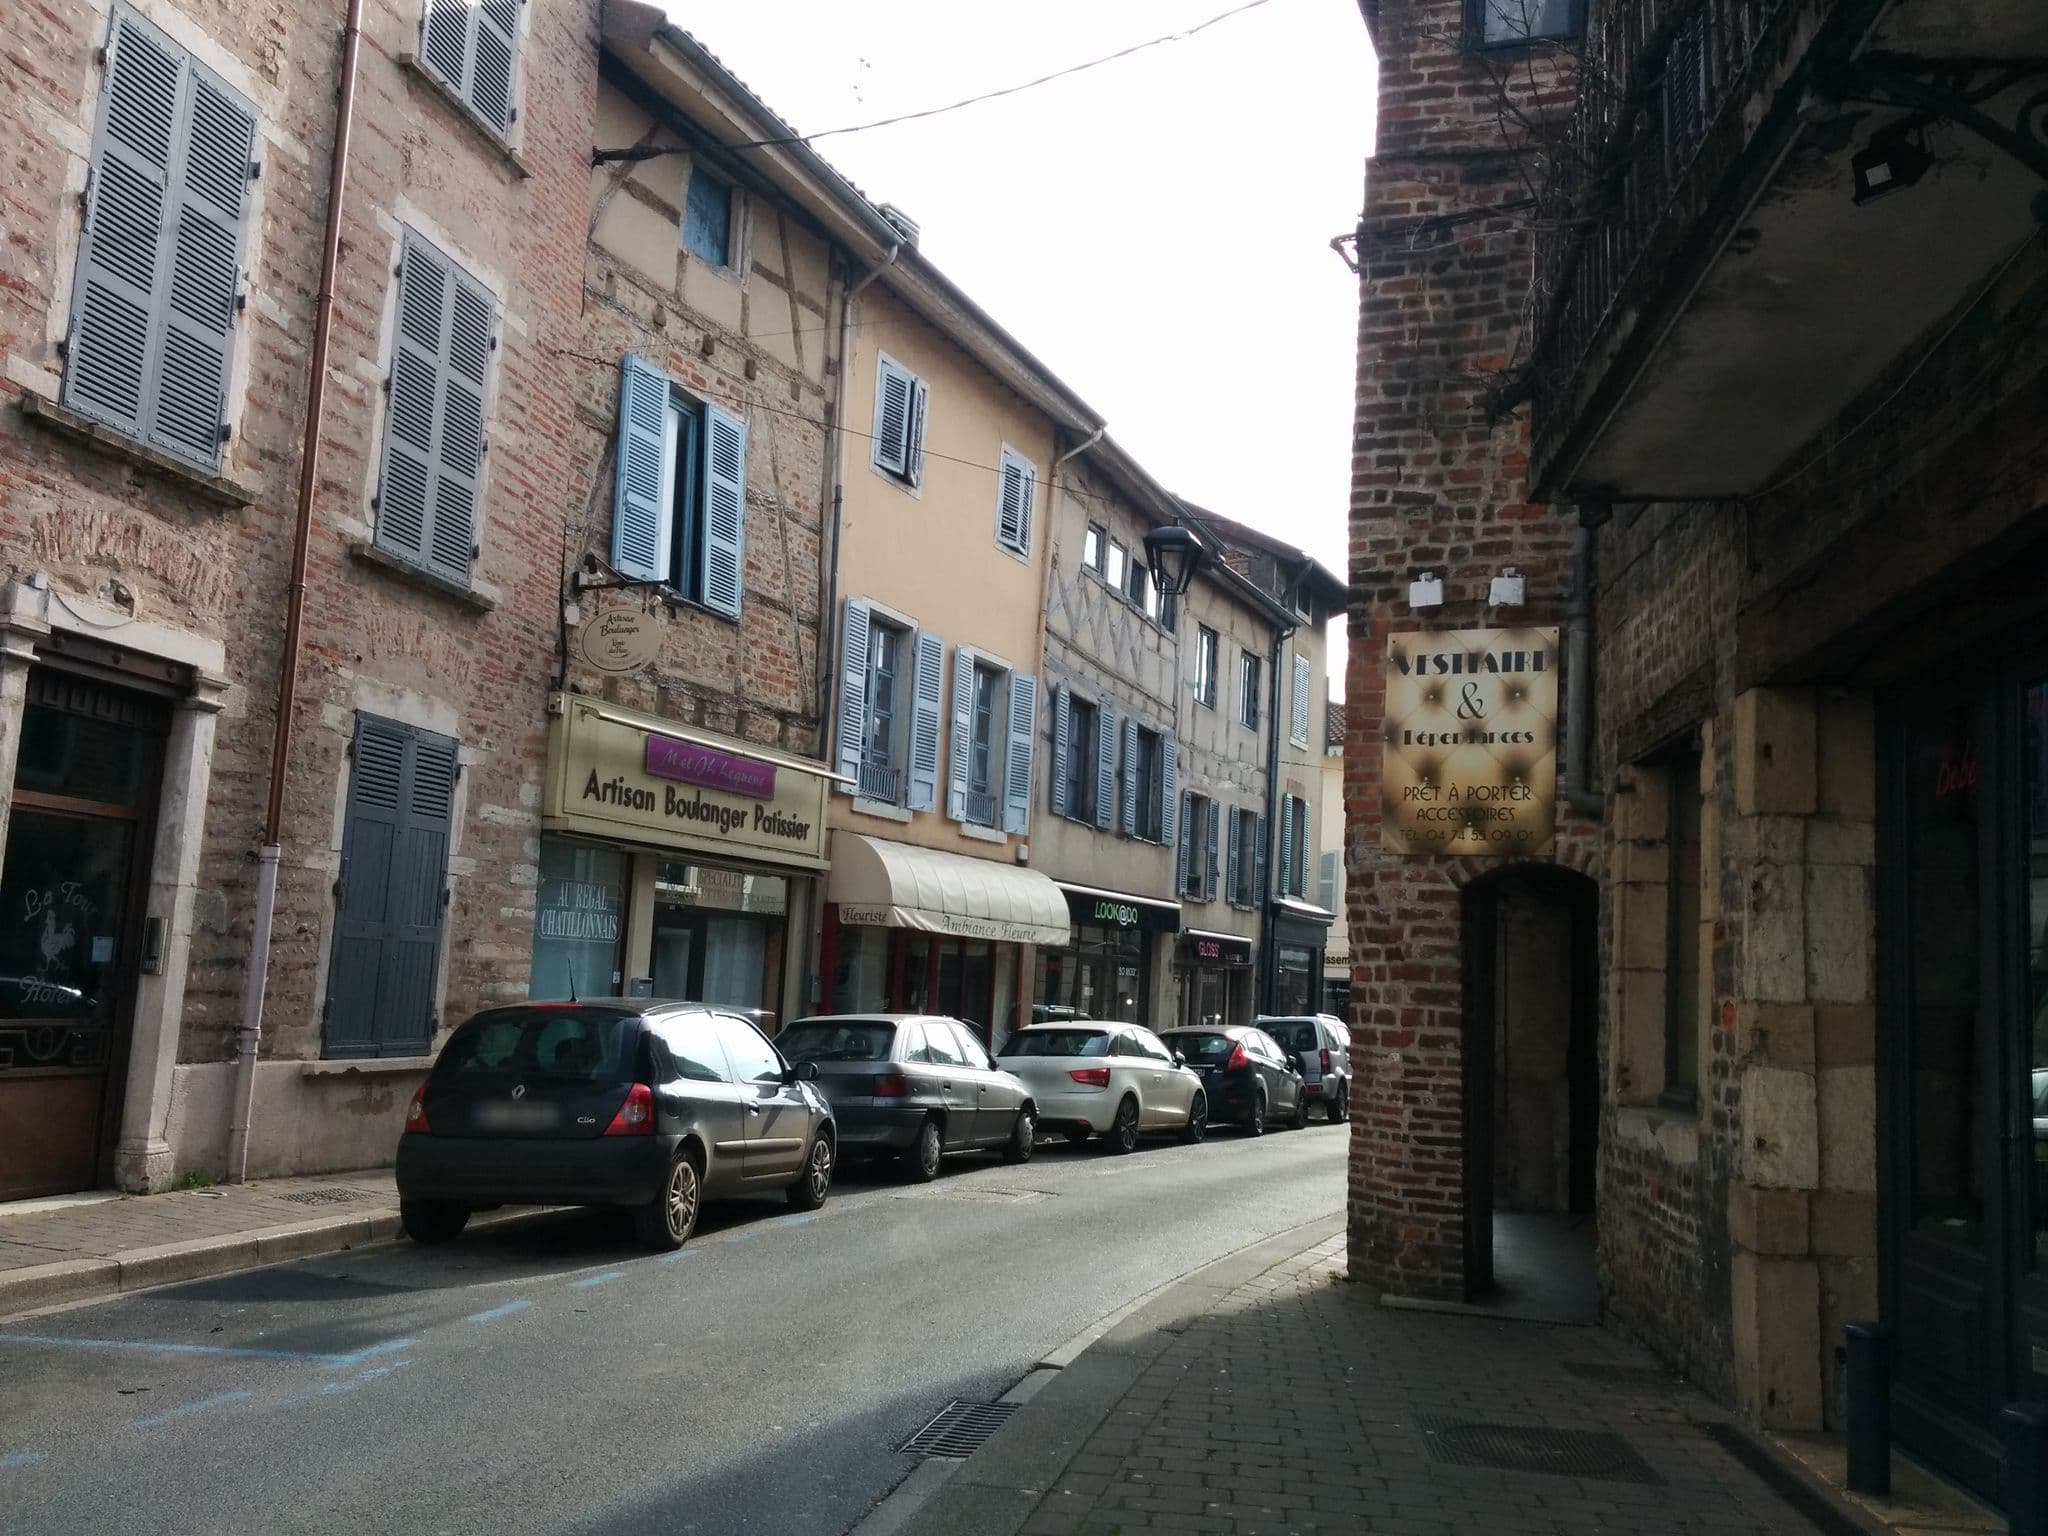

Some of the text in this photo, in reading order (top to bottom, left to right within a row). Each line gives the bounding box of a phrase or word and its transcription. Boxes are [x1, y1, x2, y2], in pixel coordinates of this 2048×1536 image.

[1392, 650, 1547, 676] VESTIAIRE
[1457, 682, 1488, 720] &
[583, 768, 811, 840] Artisan Boulanger Patissier
[1403, 782, 1532, 801] PRÊT À PORTER
[1416, 806, 1515, 821] ACCESSOIRES
[842, 906, 888, 923] Fleuriste
[1094, 901, 1138, 926] LOOK@DO
[941, 915, 1037, 941] Ambiance Fleurie
[577, 1116, 596, 1124] Clio
